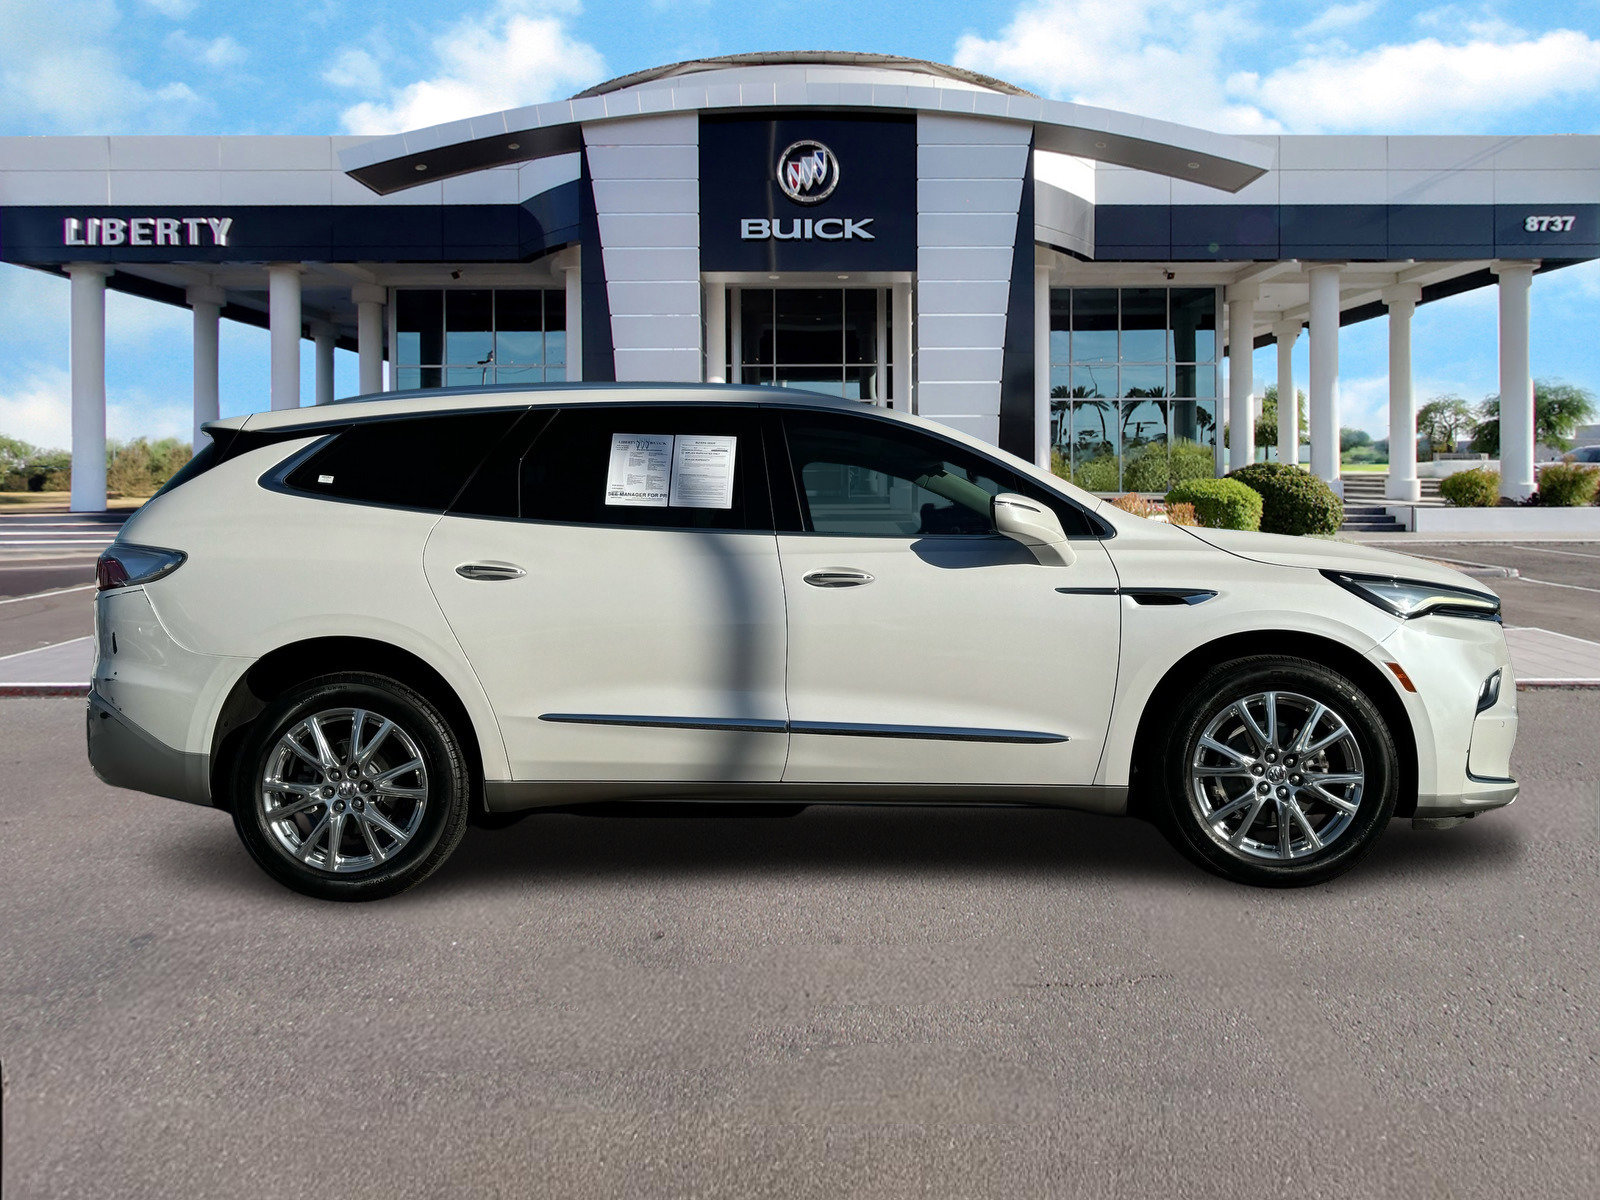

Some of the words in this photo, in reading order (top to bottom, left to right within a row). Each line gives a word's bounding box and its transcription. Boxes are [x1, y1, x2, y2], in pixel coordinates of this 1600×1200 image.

[64, 217, 233, 247] LIBERTY
[740, 218, 876, 240] BUICK
[1524, 215, 1576, 232] 8737
